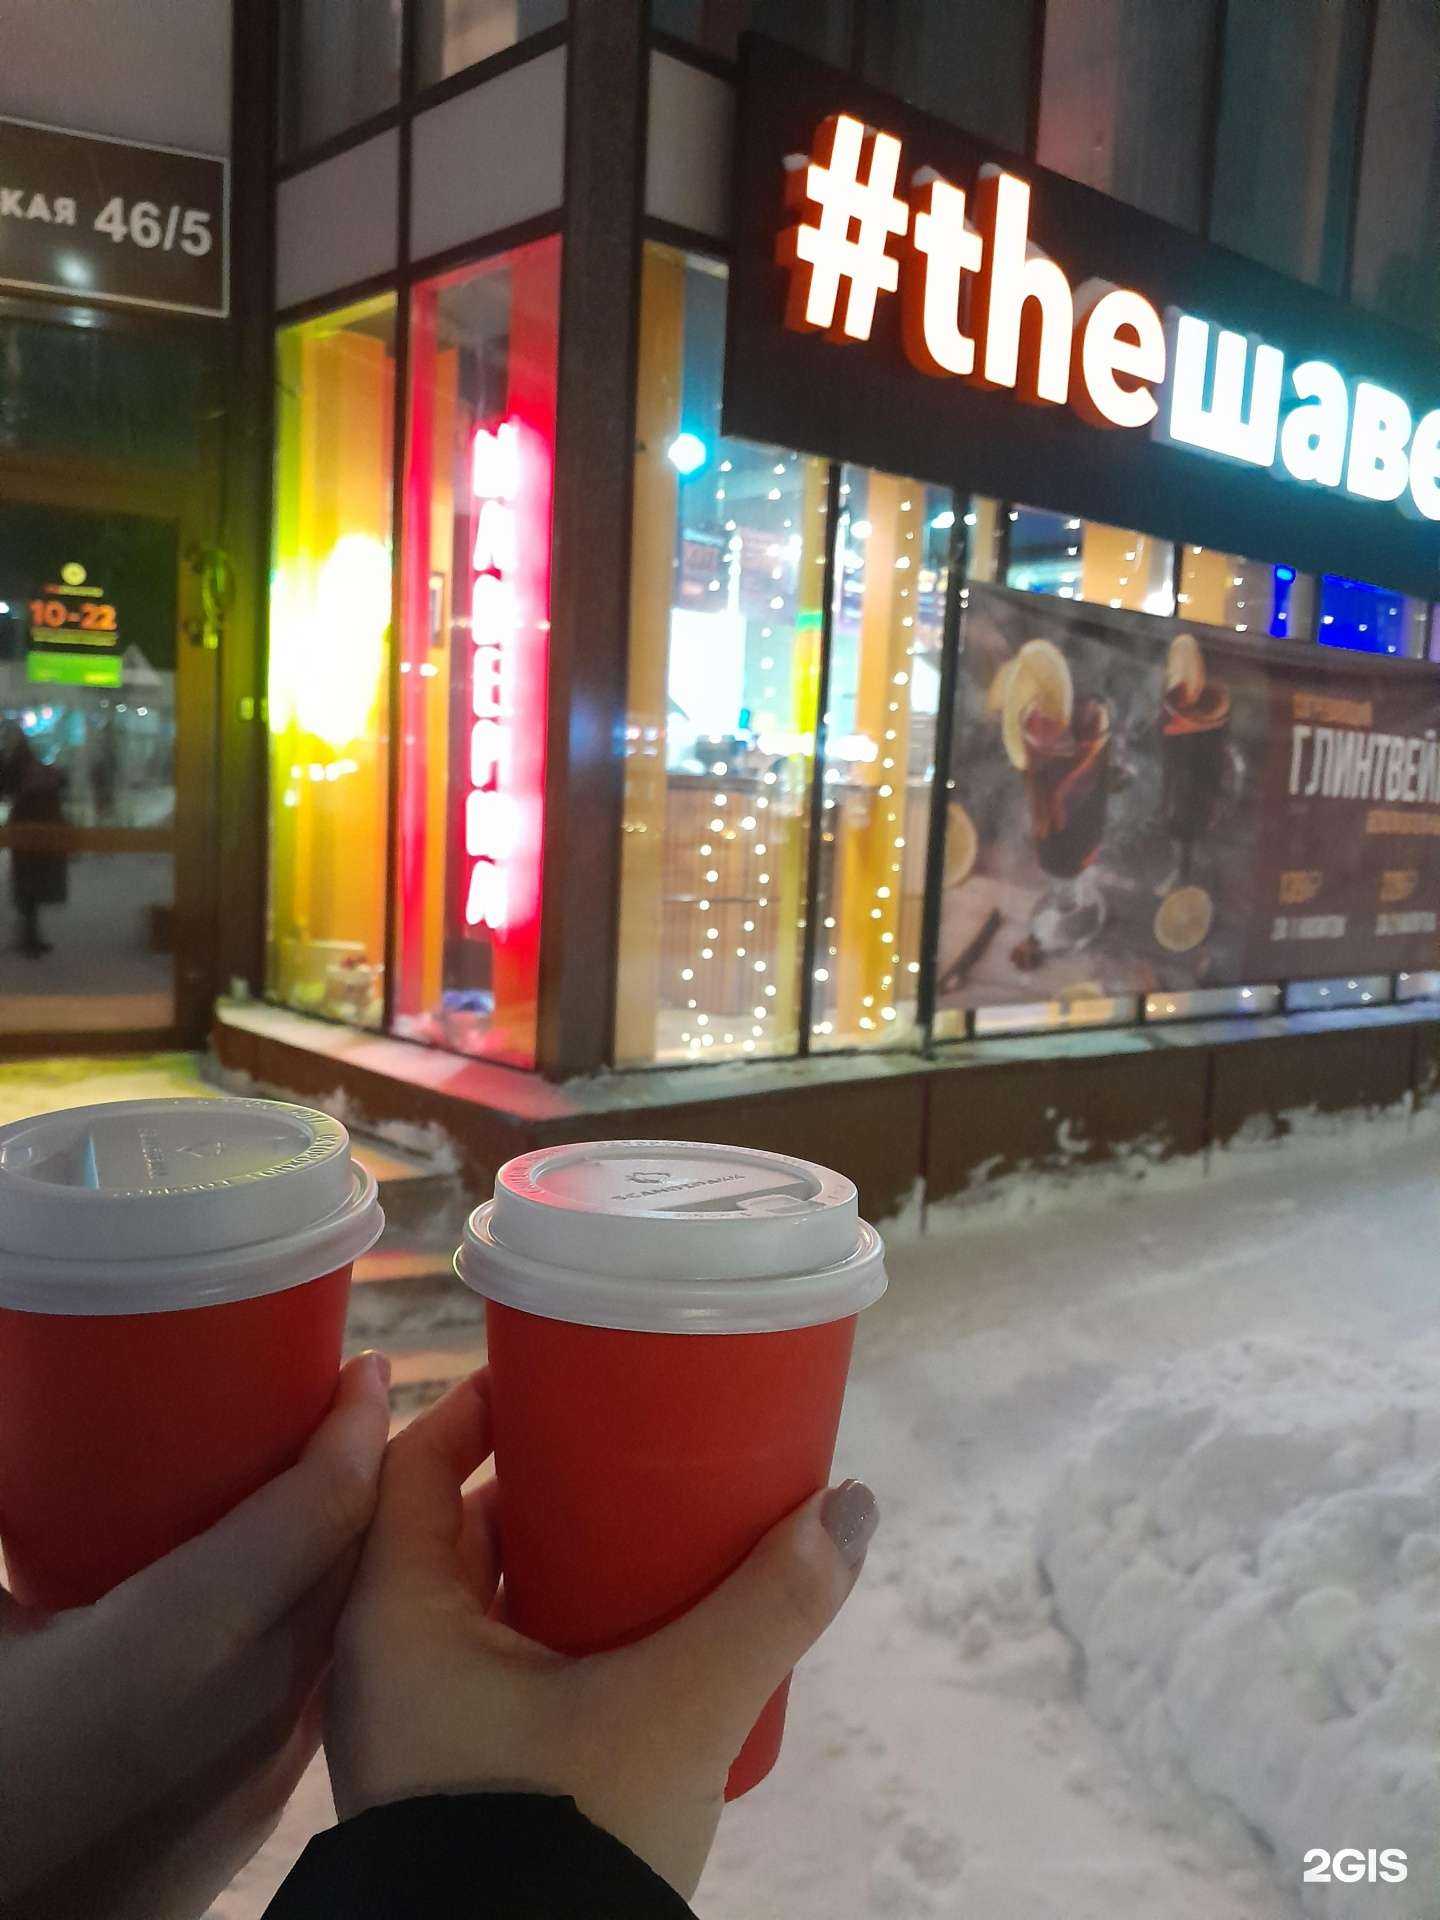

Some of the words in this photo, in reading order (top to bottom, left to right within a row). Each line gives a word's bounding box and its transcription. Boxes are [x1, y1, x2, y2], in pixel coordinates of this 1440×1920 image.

[0, 187, 77, 227] КАЯ
[94, 197, 213, 256] 46/5
[1289, 724, 1440, 804] ГЛИНТВЕЙ
